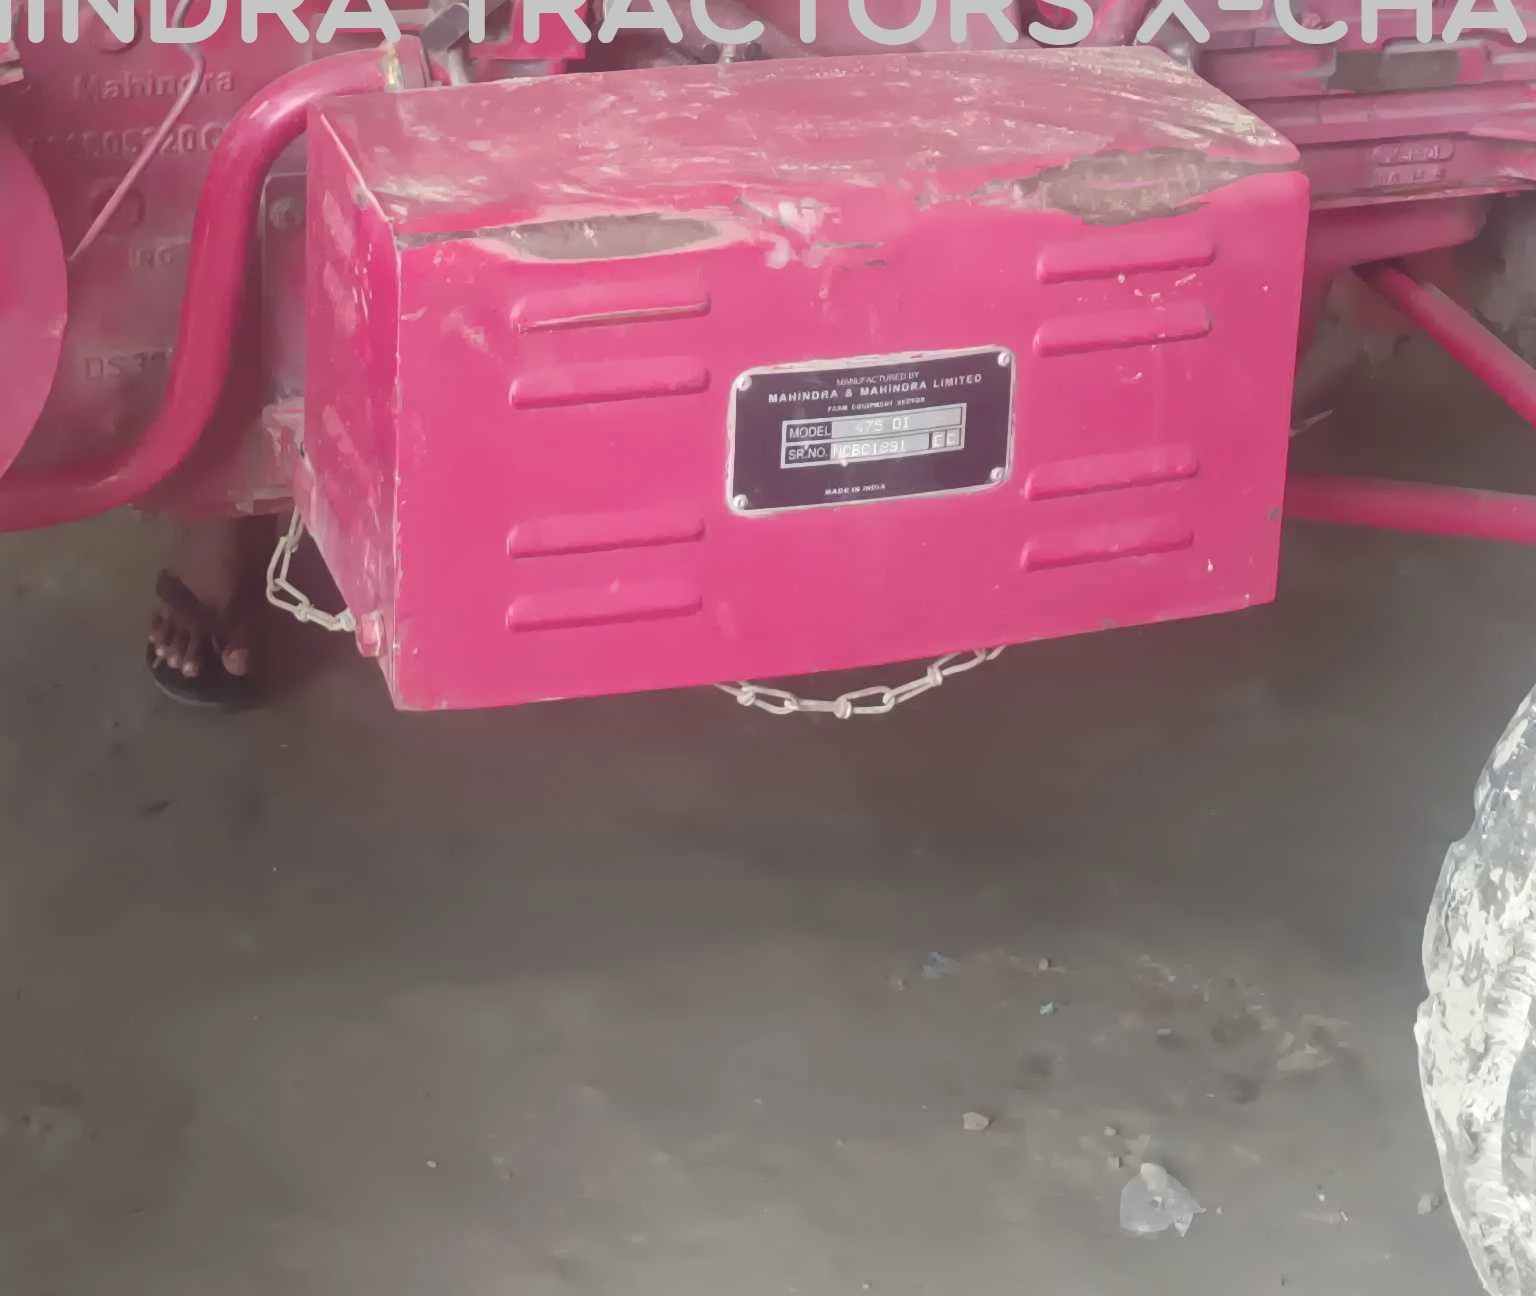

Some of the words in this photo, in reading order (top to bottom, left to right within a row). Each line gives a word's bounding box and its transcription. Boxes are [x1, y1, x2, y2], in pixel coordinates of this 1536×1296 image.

[767, 389, 839, 404] MAHINDRA
[844, 387, 853, 398] &
[859, 380, 928, 396] MAHINDRA
[932, 373, 983, 389] LIMITED
[788, 425, 832, 439] MODEL
[891, 416, 910, 431] DI
[824, 487, 850, 496] MADE
